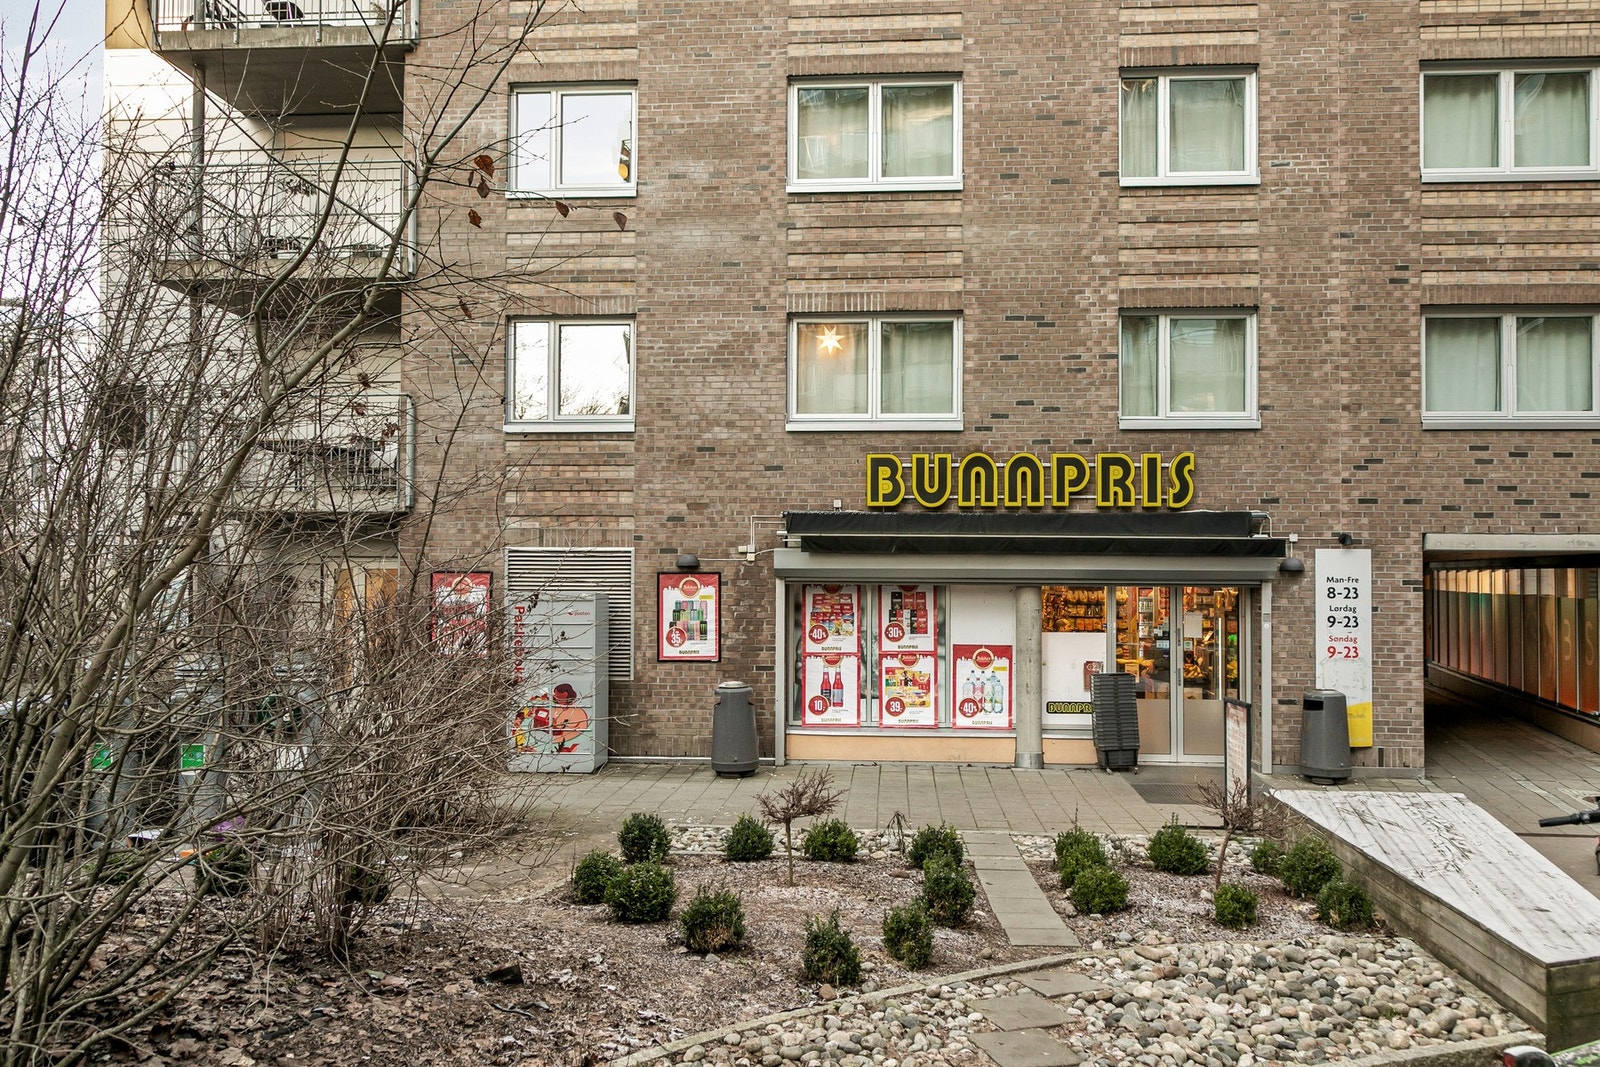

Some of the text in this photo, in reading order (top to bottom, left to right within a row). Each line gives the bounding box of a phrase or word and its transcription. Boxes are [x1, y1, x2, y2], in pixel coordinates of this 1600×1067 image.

[866, 452, 1195, 508] BUNNPRIS
[1327, 587, 1359, 599] 8-23
[1329, 605, 1357, 614] Lørdag
[1327, 616, 1359, 628] 9-23
[810, 629, 827, 640] -40%
[1328, 635, 1358, 644] Søndag
[1327, 646, 1359, 659] 9-23
[1048, 702, 1092, 713] BUNNPR
